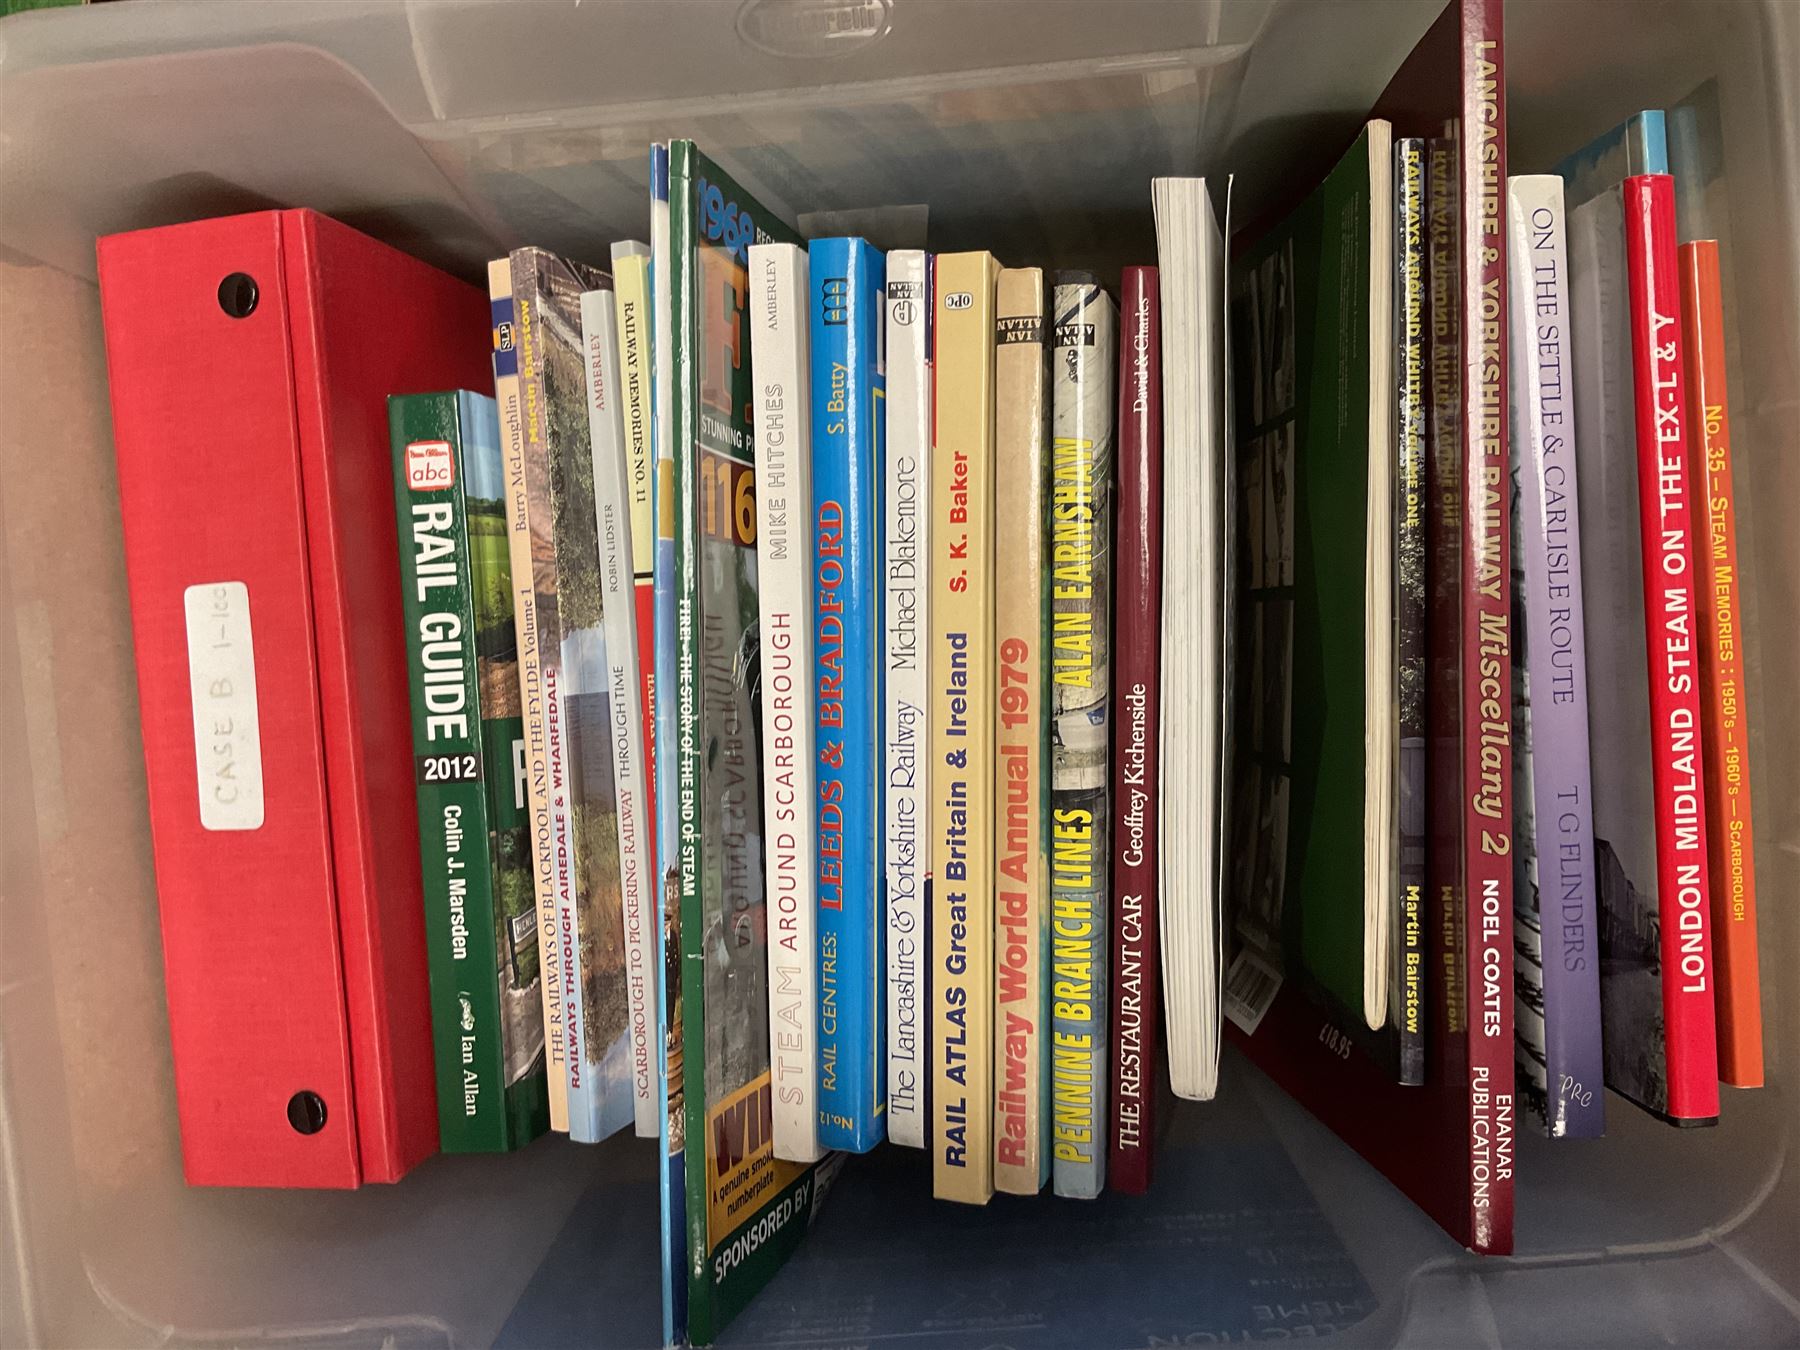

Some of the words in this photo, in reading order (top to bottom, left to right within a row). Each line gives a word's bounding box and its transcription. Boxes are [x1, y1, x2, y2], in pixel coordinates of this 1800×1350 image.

[1475, 40, 1498, 236] LANCASHIRE
[697, 177, 754, 264] 1968
[1406, 151, 1420, 245] RAILWAYS
[1531, 208, 1554, 251] ON
[1481, 251, 1499, 266] &
[1535, 259, 1557, 317] THE
[766, 258, 777, 330] AMBERLEY
[998, 320, 1041, 330] ALLAN
[1134, 298, 1149, 350] Charles
[1406, 251, 1422, 338] AROUND
[1652, 311, 1675, 332] Y
[500, 324, 512, 349] SLP
[520, 301, 535, 378] Bairstow
[624, 302, 639, 367] RAILWAY
[1005, 331, 1032, 342] IAN
[1135, 350, 1149, 367] &
[1480, 278, 1501, 456] YORKSHIRE
[1653, 341, 1676, 362] &
[591, 333, 606, 411] AMBERLEY
[828, 361, 849, 413] Batty
[1133, 369, 1148, 413] David
[1537, 325, 1563, 427] SETTLE
[1656, 372, 1681, 442] EX-L
[506, 395, 524, 490] McLoughlin
[529, 384, 539, 443] Martin
[628, 372, 643, 454] MEMORIES
[701, 414, 742, 449] STUNNING
[765, 384, 785, 488] HITCHES
[828, 418, 845, 434] S.
[1542, 434, 1564, 454] &
[413, 462, 448, 481] abc
[635, 458, 647, 485] NO.
[636, 489, 647, 503] 11
[949, 451, 968, 523] Baker
[1659, 456, 1683, 517] THE
[515, 493, 527, 533] Barry
[604, 504, 615, 549] LIDSTER
[769, 498, 787, 559] MIKE
[890, 456, 916, 580] Blakemore
[949, 533, 967, 558] K.
[1054, 437, 1093, 599] EARNSHAW
[1407, 495, 1420, 527] ONE
[1479, 467, 1502, 600] RAILWAY
[1543, 465, 1570, 600] CARLISLE
[412, 502, 457, 602] RAIL
[609, 553, 619, 593] ROBIN
[949, 569, 968, 593] S.
[1662, 530, 1686, 575] ON
[522, 601, 535, 655] Volume
[819, 500, 844, 728] BRADFORD
[891, 589, 916, 671] Michael
[1665, 587, 1692, 695] STEAM
[419, 611, 468, 741] GUIDE
[612, 665, 624, 699] TIME
[680, 653, 692, 683] THE
[946, 633, 967, 736] Ireland
[1000, 638, 1028, 730] 1979
[1054, 612, 1092, 688] ALAN
[1549, 607, 1574, 705] ROUTE
[1708, 447, 1726, 472] 35
[1729, 820, 1746, 922] SCARBOROUGH
[209, 677, 233, 698] B
[526, 660, 541, 717] FYLDE
[680, 686, 693, 734] STORY
[771, 612, 796, 821] SCARBOROUGH
[1473, 610, 1509, 819] Miscellany
[214, 717, 239, 804] CASE
[530, 719, 544, 757] THE
[545, 668, 564, 789] WHARFEDALE
[614, 702, 632, 780] THROUGH
[681, 737, 693, 756] OF
[820, 741, 844, 769] &
[890, 700, 924, 789] Railway
[946, 748, 967, 768] &
[1124, 684, 1146, 785] Kichenside
[424, 756, 477, 780] 2012
[534, 763, 546, 799] AND
[555, 795, 565, 807] &
[681, 758, 693, 788] THE
[1557, 785, 1578, 803] T
[1670, 707, 1700, 849] MIDLAND
[444, 805, 463, 852] Colin
[620, 788, 637, 854] RAILWAY
[681, 790, 694, 821] END
[682, 824, 694, 843] OF
[946, 782, 967, 881] Britain
[1000, 745, 1028, 883] Annual
[1123, 789, 1148, 867] Geoffrey
[1558, 812, 1579, 833] G
[447, 856, 463, 873] J.
[538, 807, 554, 908] BLACKPOOL
[556, 813, 570, 900] AIREDALE
[682, 846, 695, 896] STEAM
[820, 779, 844, 912] LEEDS
[890, 798, 915, 896] Yorkshire
[1054, 809, 1092, 888] LINES
[1480, 831, 1510, 856] 2
[448, 876, 470, 960] Marsden
[543, 913, 556, 936] OF
[625, 857, 640, 945] PICKERING
[777, 833, 797, 951] AROUND
[890, 910, 915, 933] &
[1122, 894, 1142, 942] CAR
[1406, 886, 1420, 948] Martin
[1482, 880, 1499, 942] NOEL
[1560, 842, 1586, 973] FLINDERS
[560, 905, 576, 994] THROUGH
[630, 949, 642, 971] TO
[946, 892, 967, 975] Great
[999, 892, 1028, 1004] World
[1054, 900, 1092, 1020] BRANCH
[1677, 865, 1706, 993] LONDON
[545, 941, 562, 1025] RAILWAYS
[822, 931, 838, 1036] CENTRES:
[890, 938, 915, 1063] Lancashire
[1406, 952, 1420, 1034] Bairstow
[1482, 947, 1500, 1037] COATES
[461, 1034, 476, 1064] Ian
[551, 1028, 564, 1064] THE
[562, 1002, 580, 1088] RAILWAYS
[631, 975, 650, 1098] SCARBOROUGH
[777, 965, 803, 1105] STEAM
[946, 986, 966, 1086] ATLAS
[1120, 946, 1142, 1099] RESTAURANT
[1319, 1023, 1352, 1059] £18.95
[463, 1070, 479, 1116] Allan
[823, 1043, 836, 1091] RAIL
[891, 1070, 915, 1115] The
[998, 1011, 1033, 1167] Railway
[1054, 1031, 1092, 1163] PENNINE
[819, 1111, 853, 1130] No.12
[946, 1097, 966, 1167] RAIL
[1119, 1103, 1140, 1150] THE
[1473, 1067, 1490, 1208] PUBLICATIONS
[1496, 1095, 1512, 1181] ENANAR
[712, 1186, 718, 1205] A
[719, 1169, 750, 1201] genuine
[727, 1171, 775, 1217] numberplate
[715, 1197, 792, 1285] SPONSORED
[794, 1179, 811, 1215] BY
